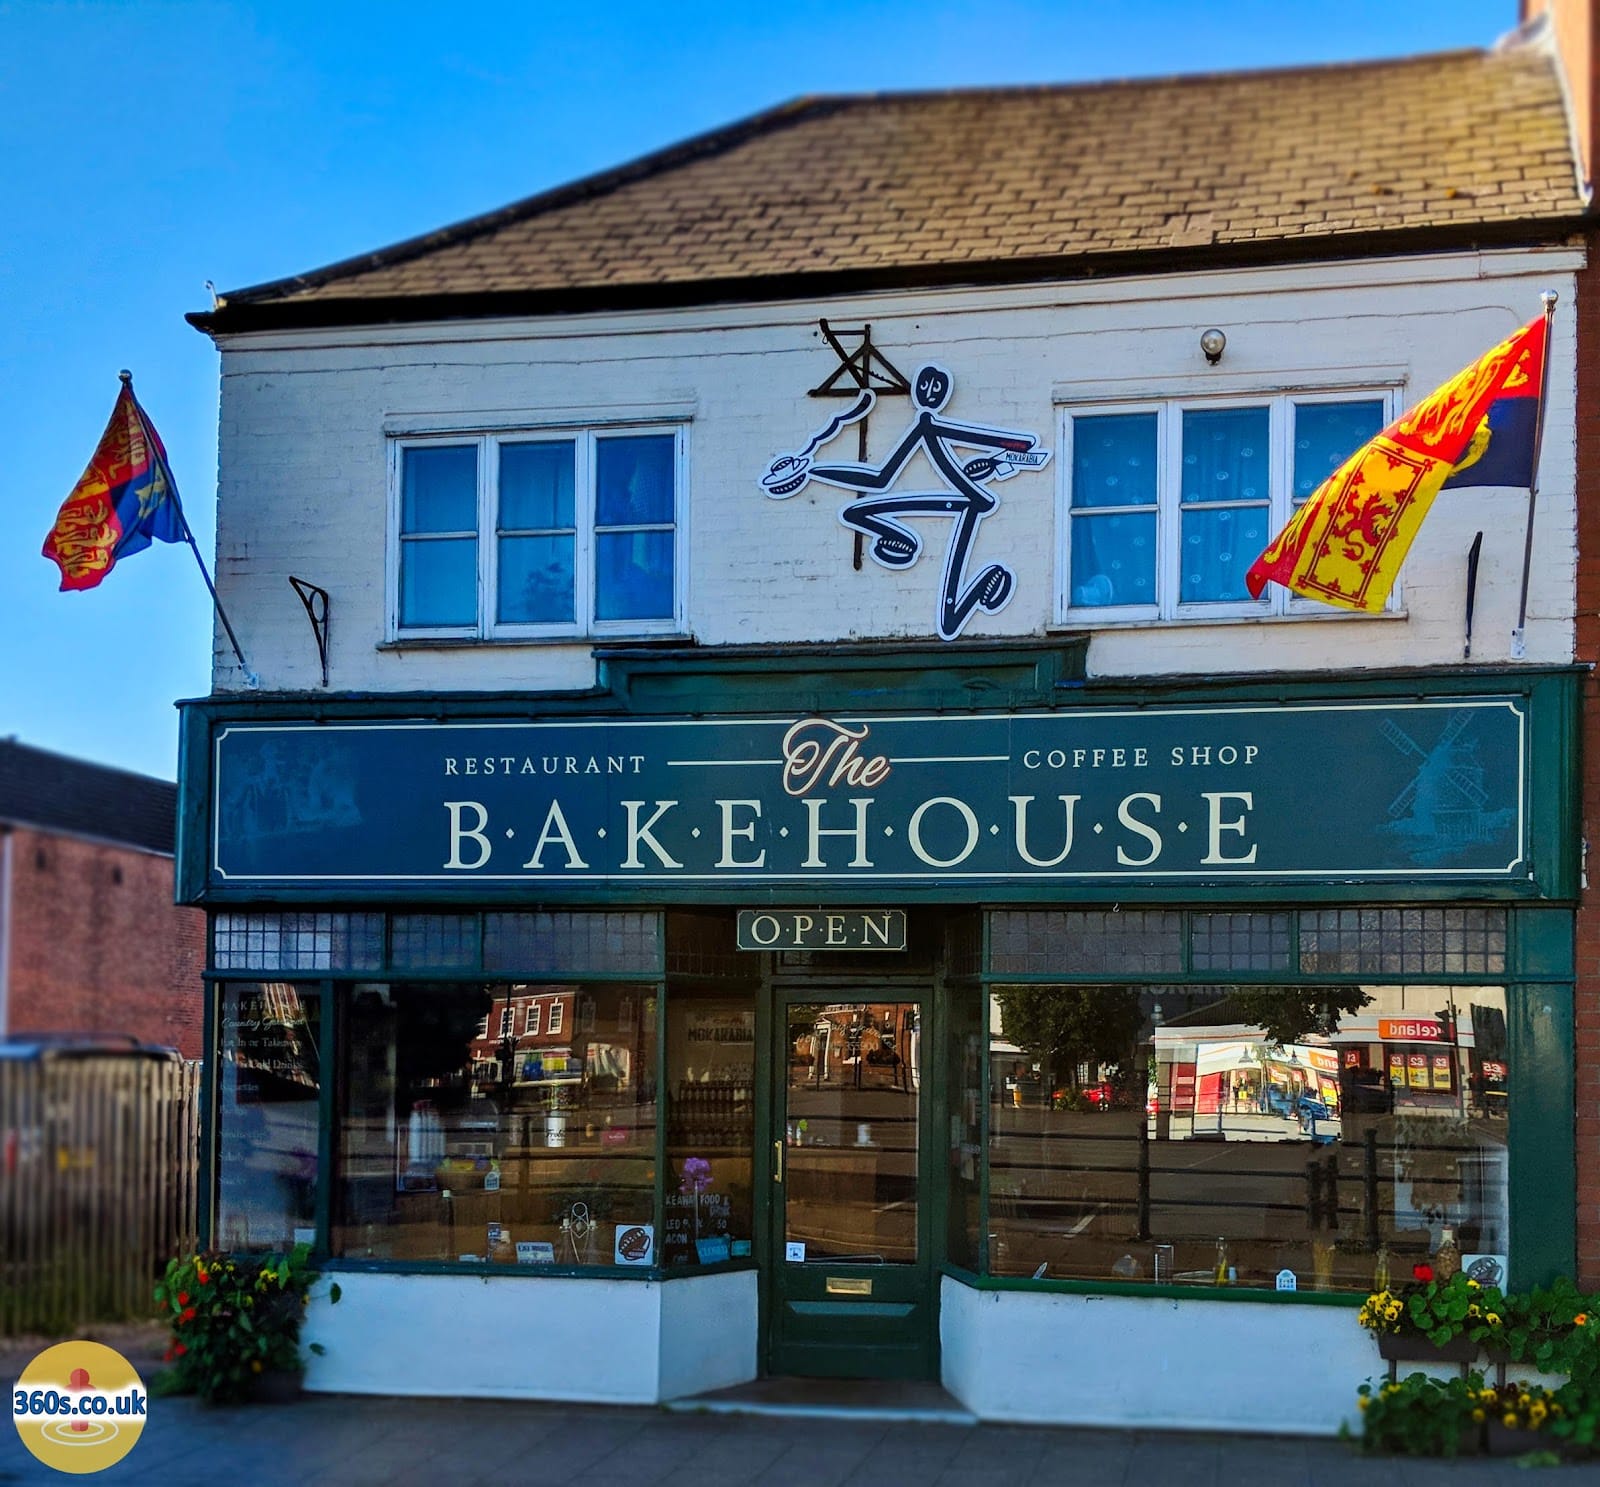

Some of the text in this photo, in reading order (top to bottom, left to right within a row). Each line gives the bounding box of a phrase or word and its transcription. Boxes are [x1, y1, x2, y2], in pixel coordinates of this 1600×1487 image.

[1005, 452, 1038, 464] MOKARABIA
[444, 755, 647, 776] RESTAURANT
[782, 718, 891, 796] The
[1023, 745, 1260, 769] COFFEE SHOP
[665, 1232, 688, 1245] ACON
